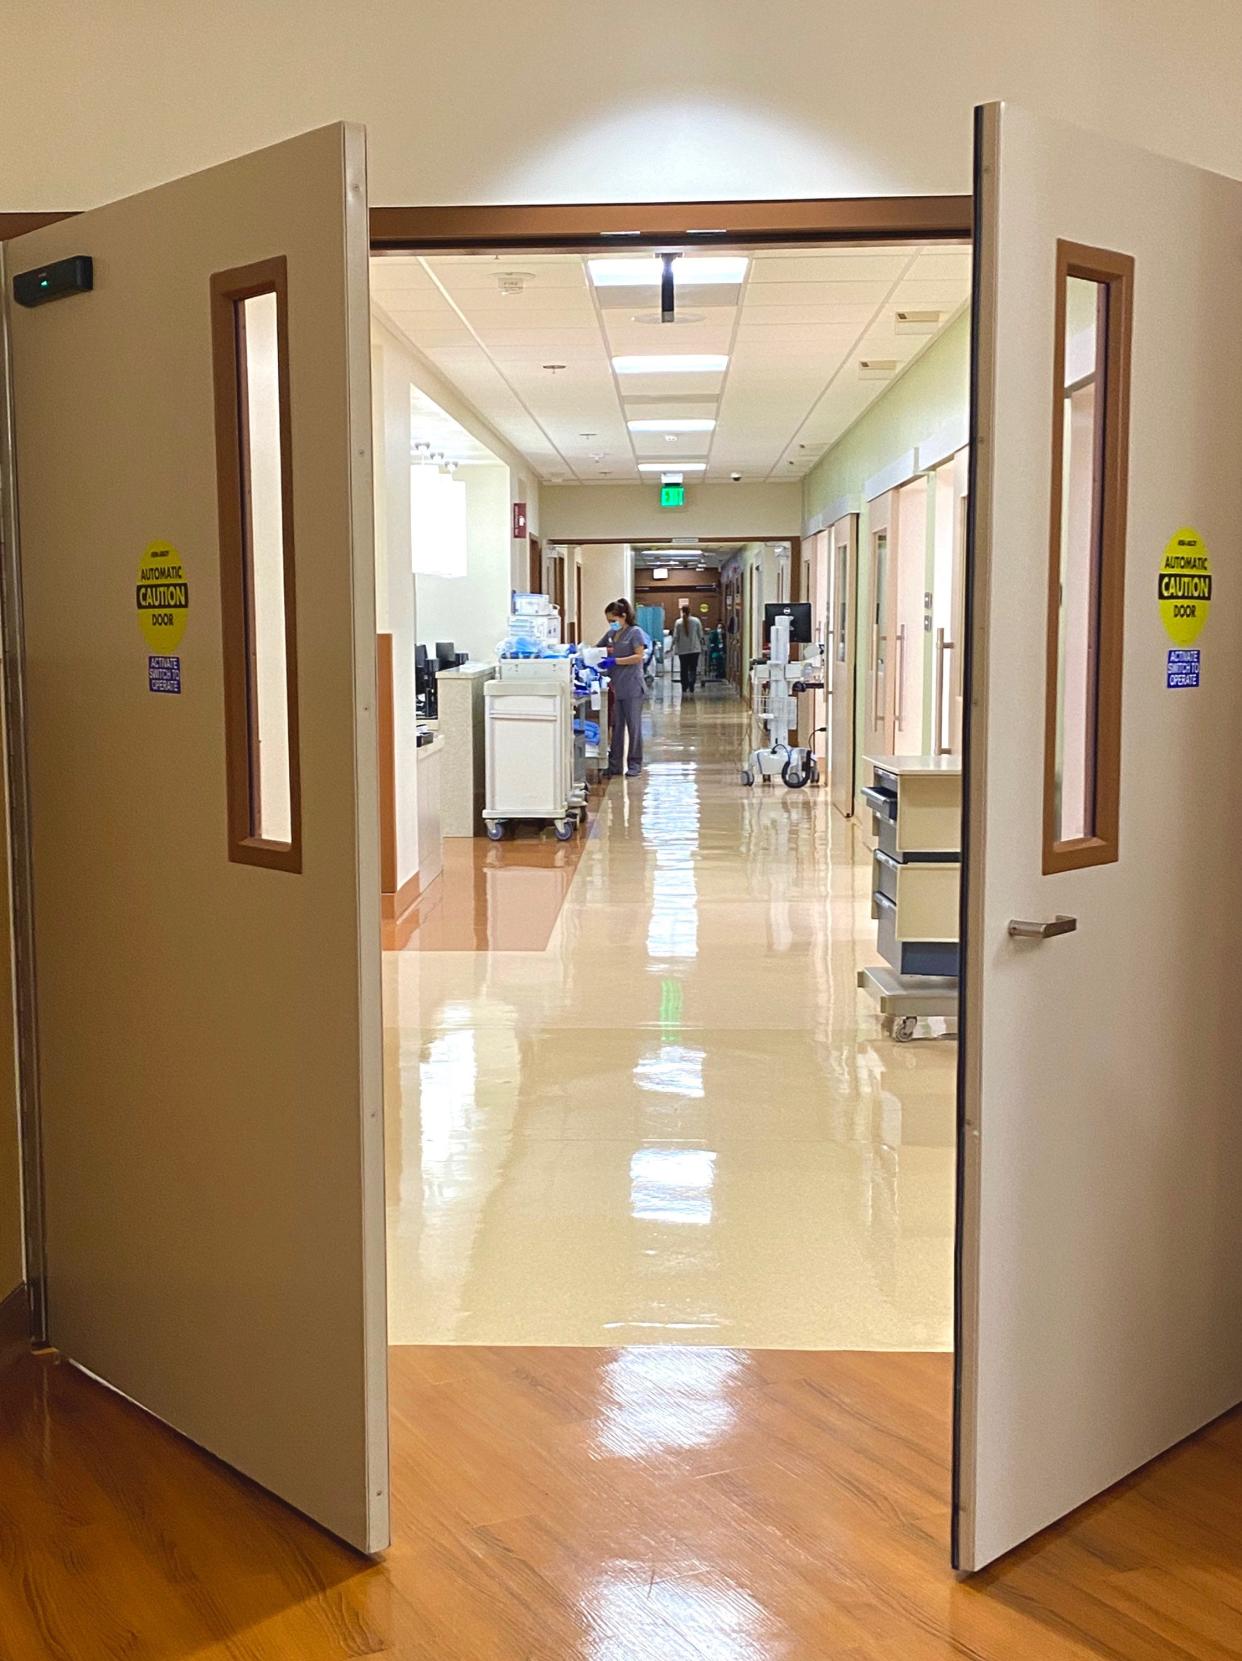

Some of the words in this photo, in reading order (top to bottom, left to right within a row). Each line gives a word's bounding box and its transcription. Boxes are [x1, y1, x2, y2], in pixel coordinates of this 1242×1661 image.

[1165, 555, 1208, 571] AUTOMATIC
[141, 565, 182, 580] AUTOMATIC
[1162, 576, 1209, 597] CAUTION
[140, 585, 186, 606] CAUTION
[1173, 604, 1197, 618] DOOR
[151, 613, 174, 626] DOOR
[150, 657, 179, 669] ACTIVATE
[1169, 651, 1198, 662] ACTIVATE
[149, 668, 171, 680] SWITCH
[172, 669, 180, 681] TO
[1168, 662, 1191, 674] SWITCH
[1191, 662, 1200, 673] TO
[151, 680, 179, 692] OPERATE
[1169, 674, 1197, 686] OPERATE
